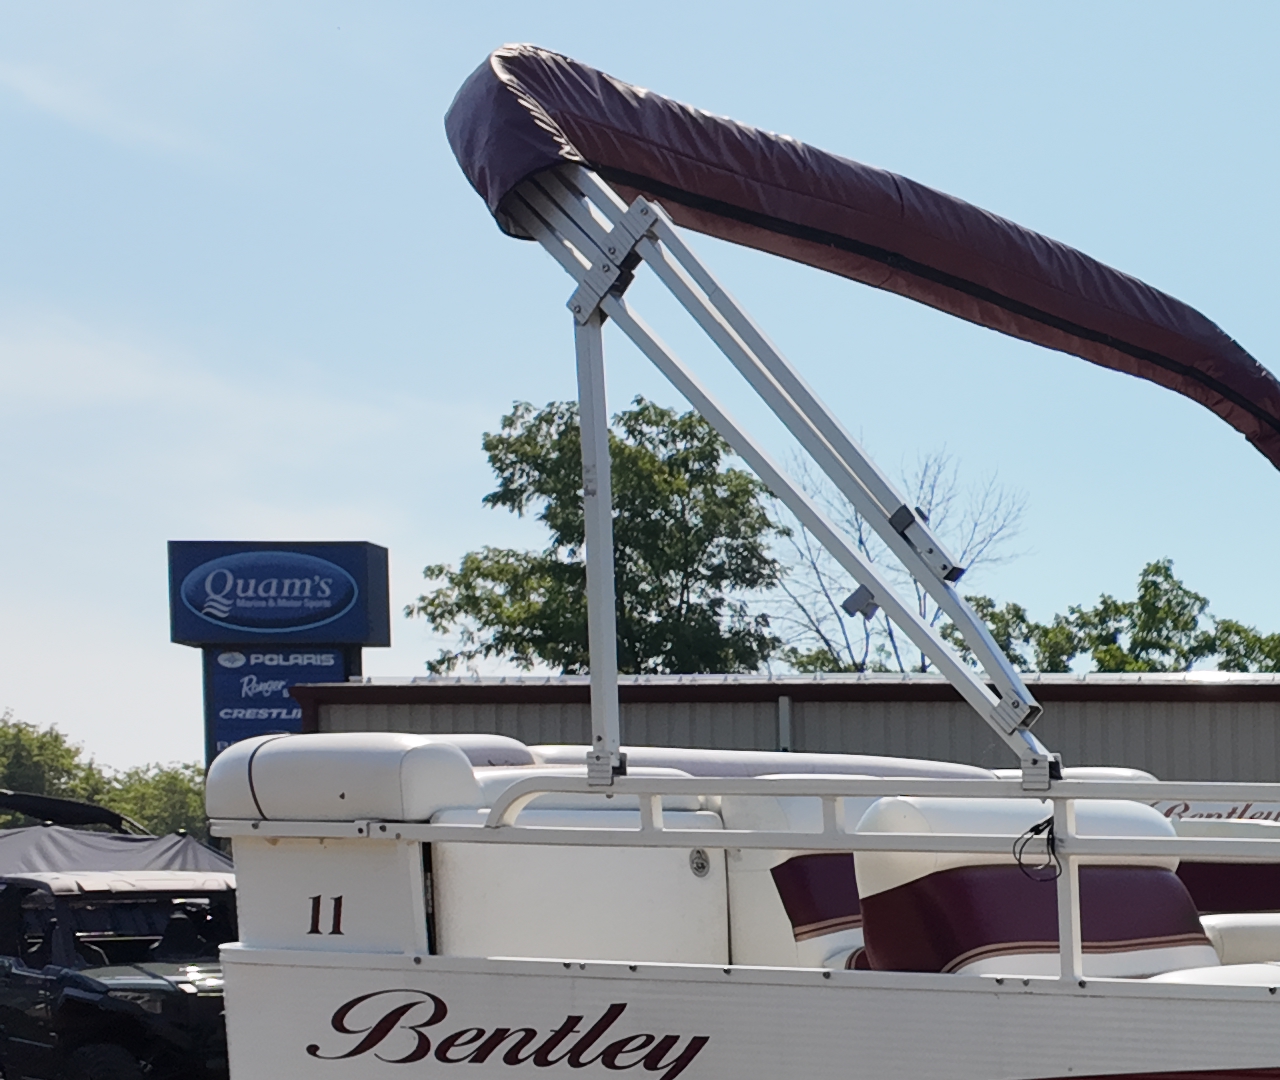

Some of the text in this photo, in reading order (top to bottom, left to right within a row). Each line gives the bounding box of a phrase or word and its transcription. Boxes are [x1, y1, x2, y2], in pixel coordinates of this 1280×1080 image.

[204, 568, 333, 605] Quam's
[250, 653, 335, 667] POLARIS
[240, 674, 287, 698] Ranger
